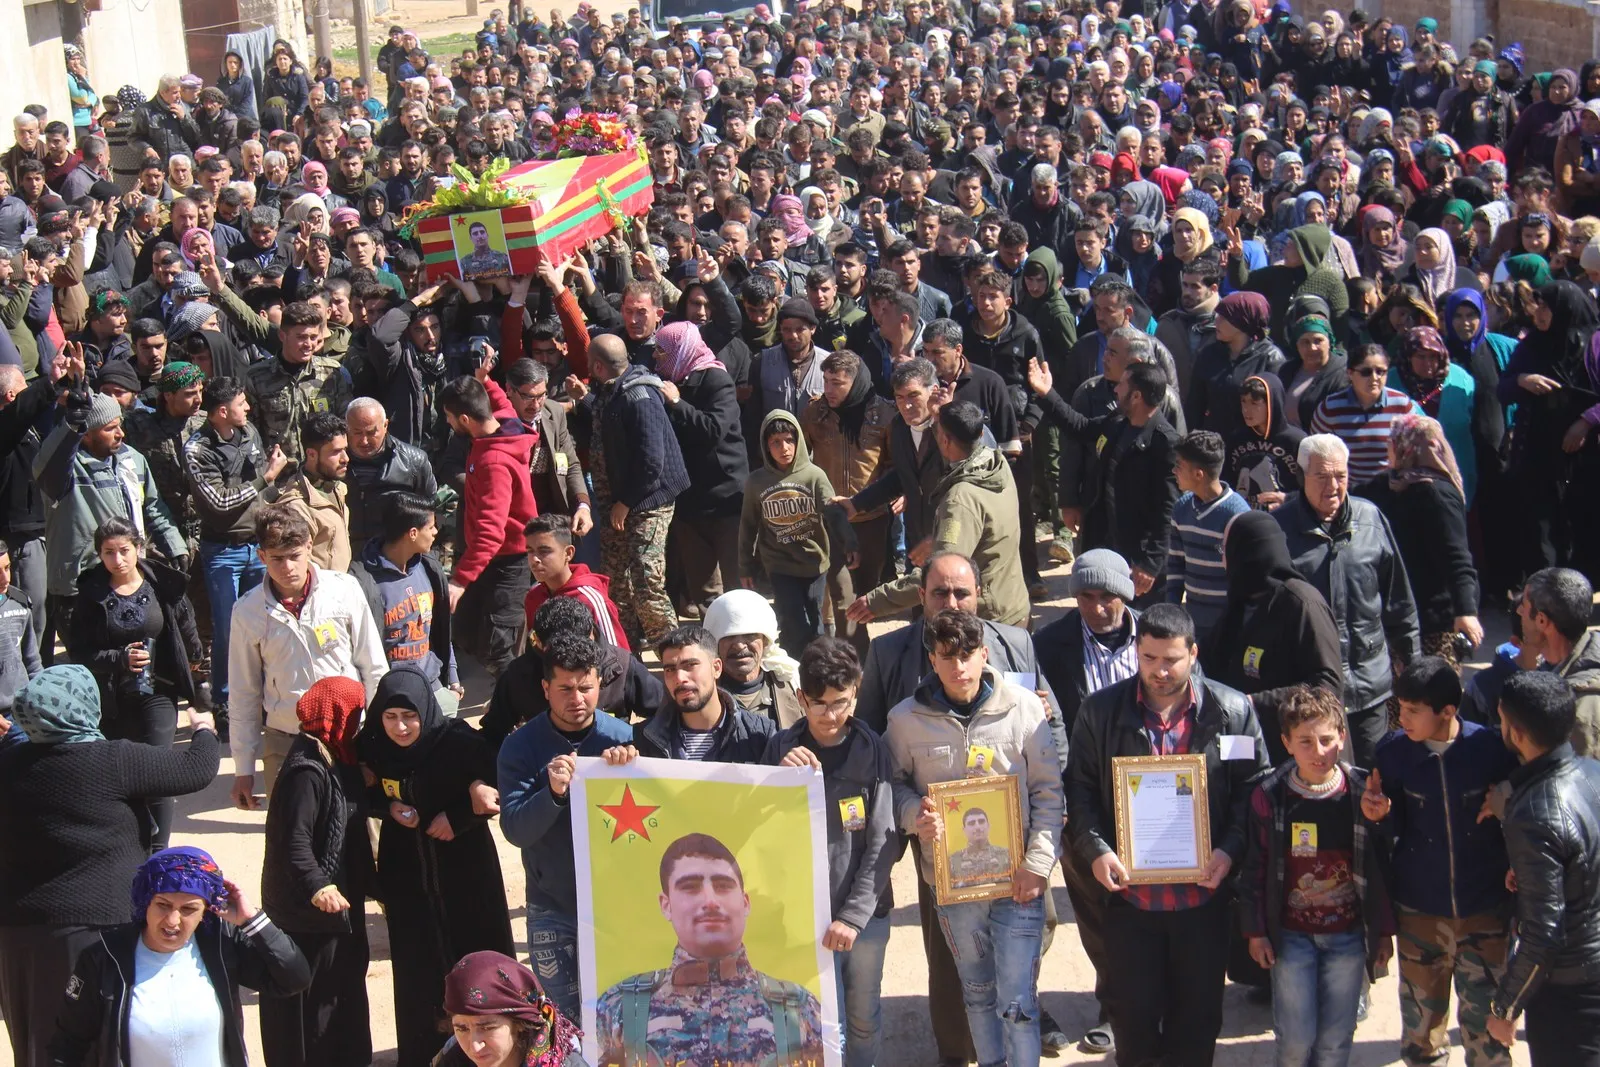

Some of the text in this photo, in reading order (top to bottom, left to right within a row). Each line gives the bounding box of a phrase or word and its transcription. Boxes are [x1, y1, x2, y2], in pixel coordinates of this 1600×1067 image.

[603, 818, 658, 844] Y P G
